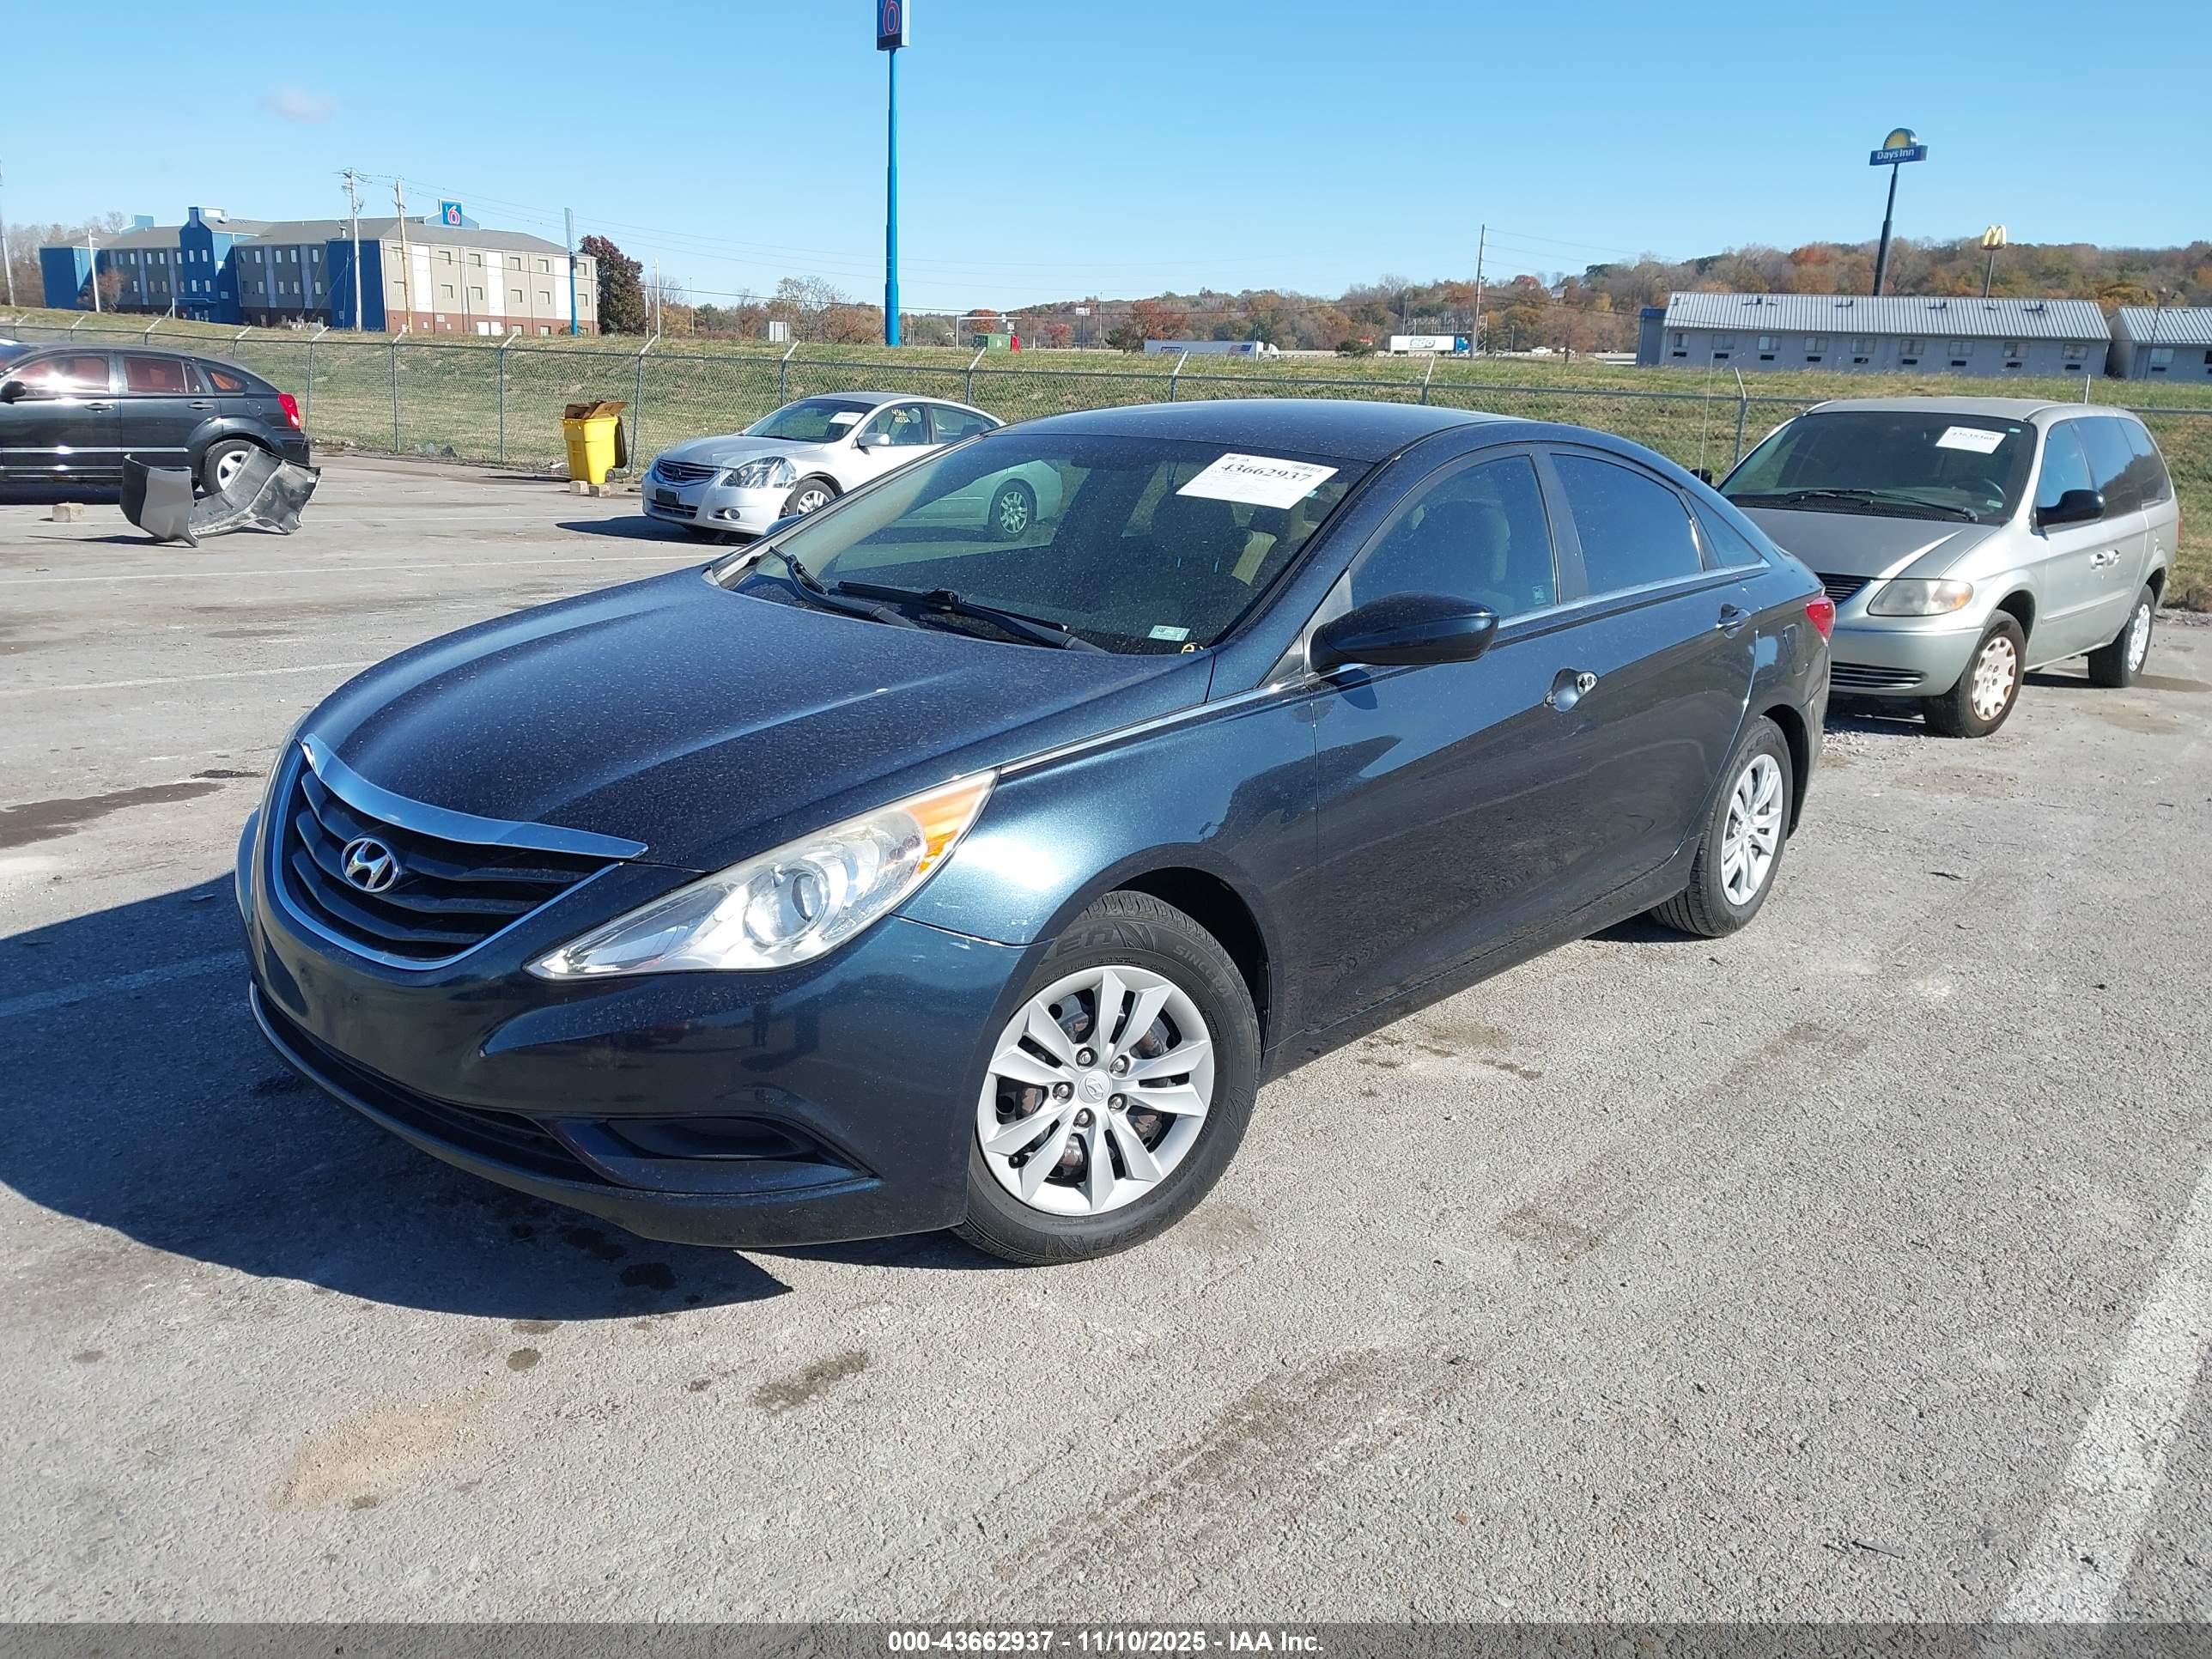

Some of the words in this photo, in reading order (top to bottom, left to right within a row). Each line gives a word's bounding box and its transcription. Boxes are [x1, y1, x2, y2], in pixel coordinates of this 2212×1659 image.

[883, 0, 901, 35] 6
[1876, 150, 1899, 160] Days
[1899, 149, 1915, 158] Inn
[447, 205, 460, 225] 6
[1221, 463, 1312, 482] 43662937
